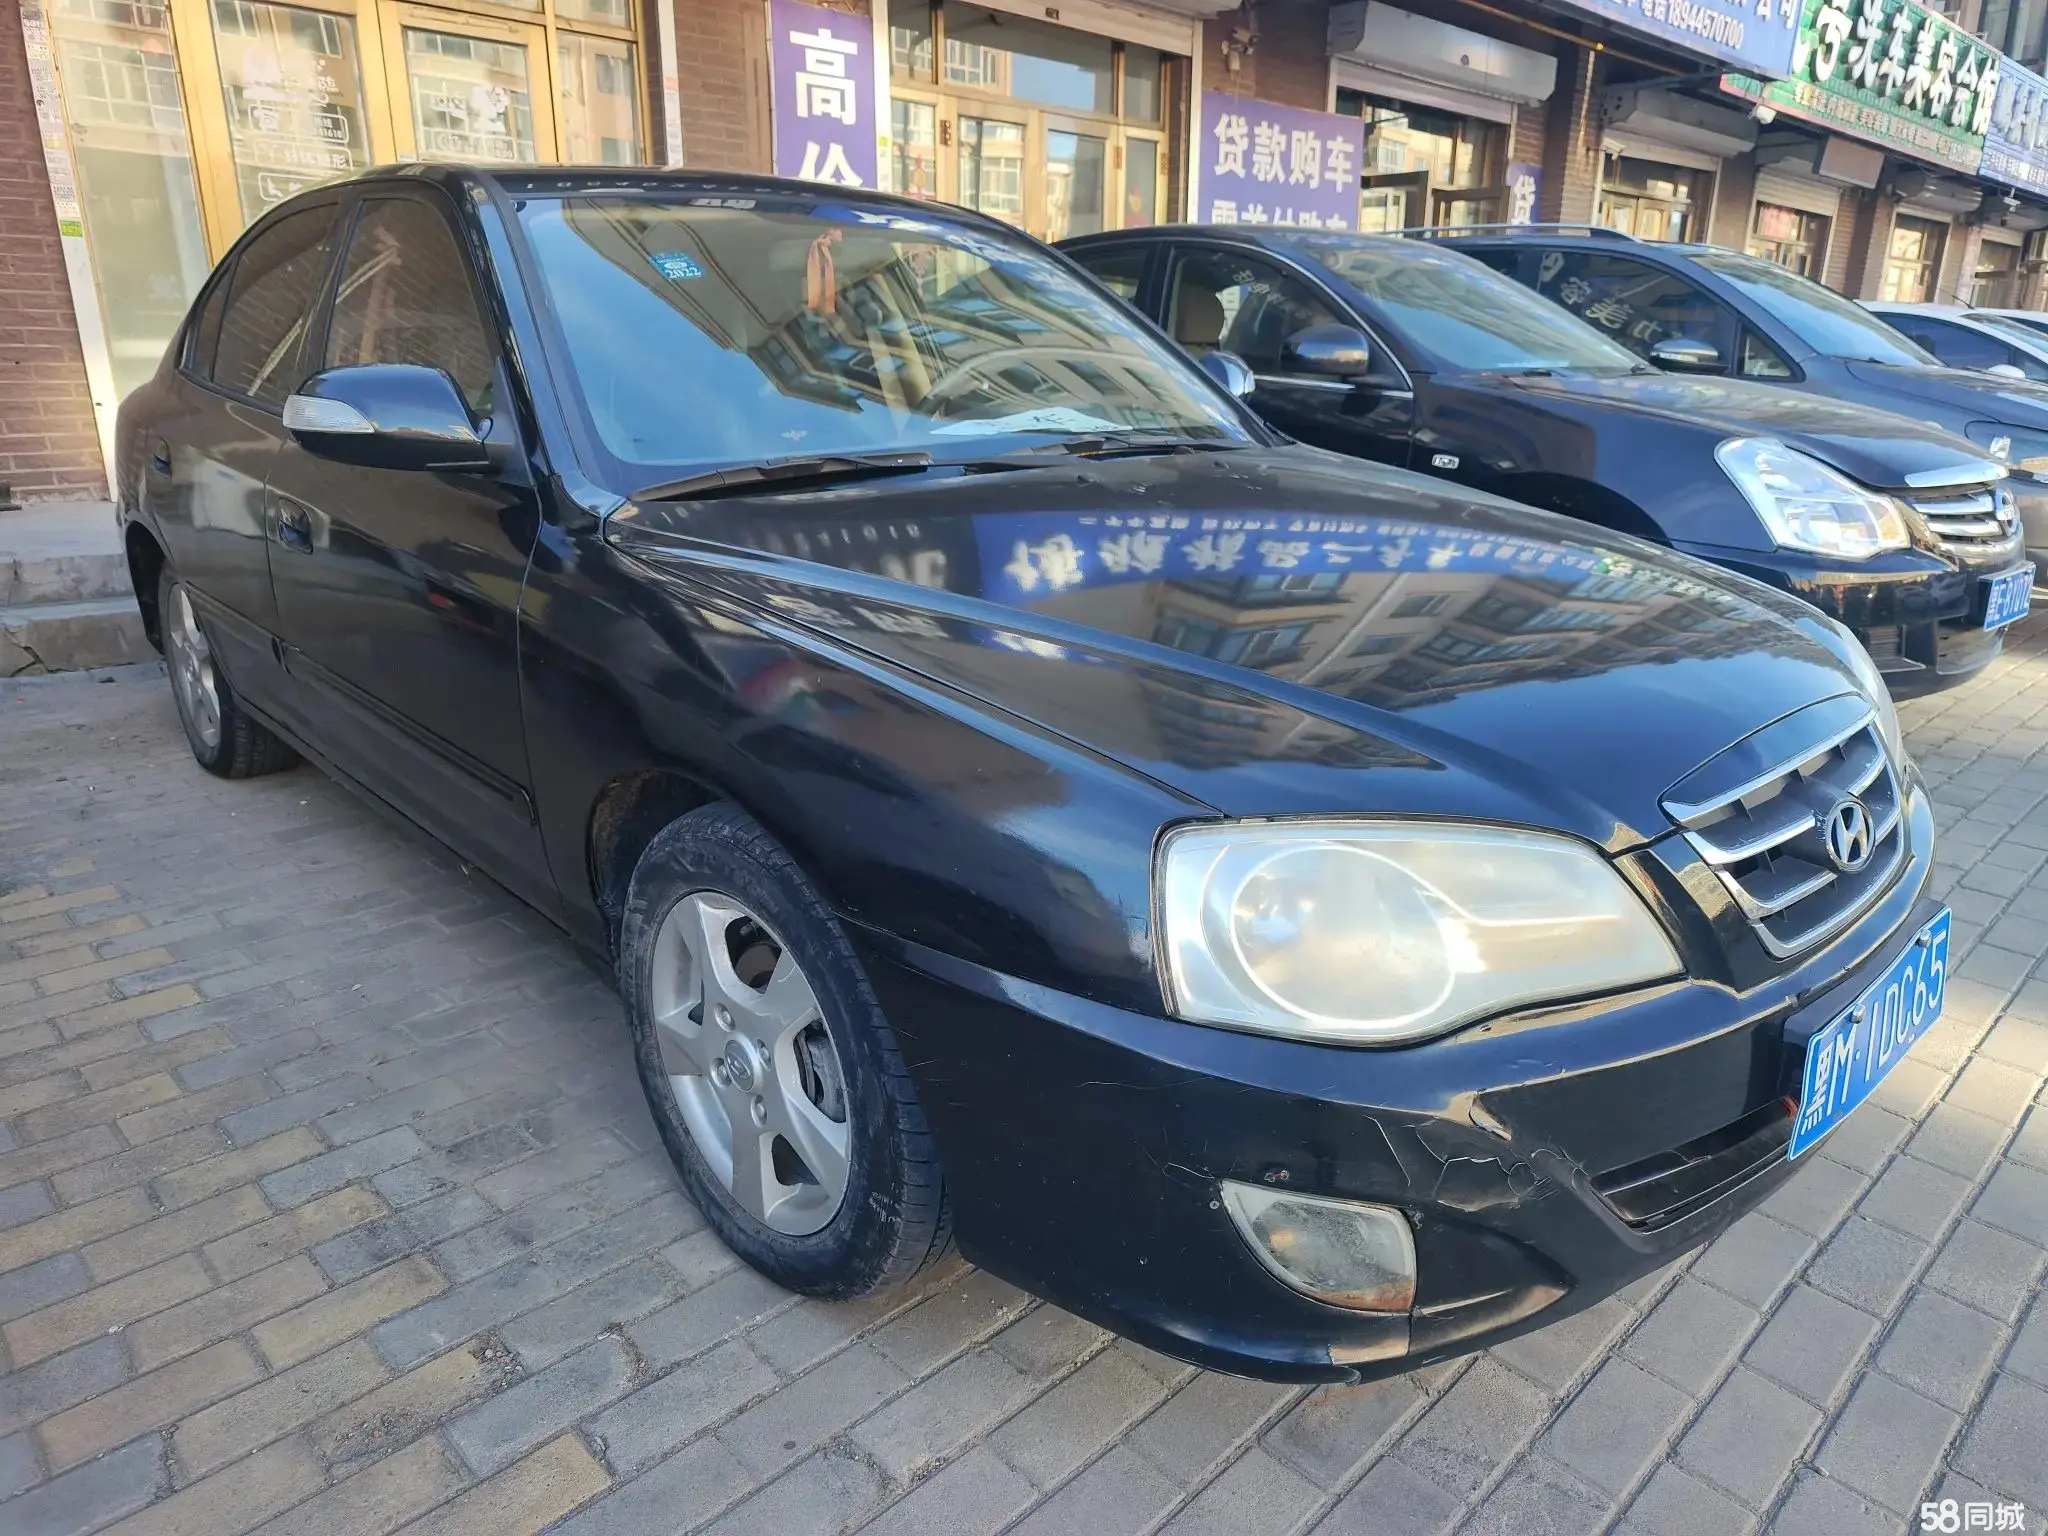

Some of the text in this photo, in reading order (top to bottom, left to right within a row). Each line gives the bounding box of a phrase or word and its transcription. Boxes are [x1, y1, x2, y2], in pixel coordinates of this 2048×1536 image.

[1213, 113, 1355, 194] 贷款购车
[665, 266, 703, 280] 2022
